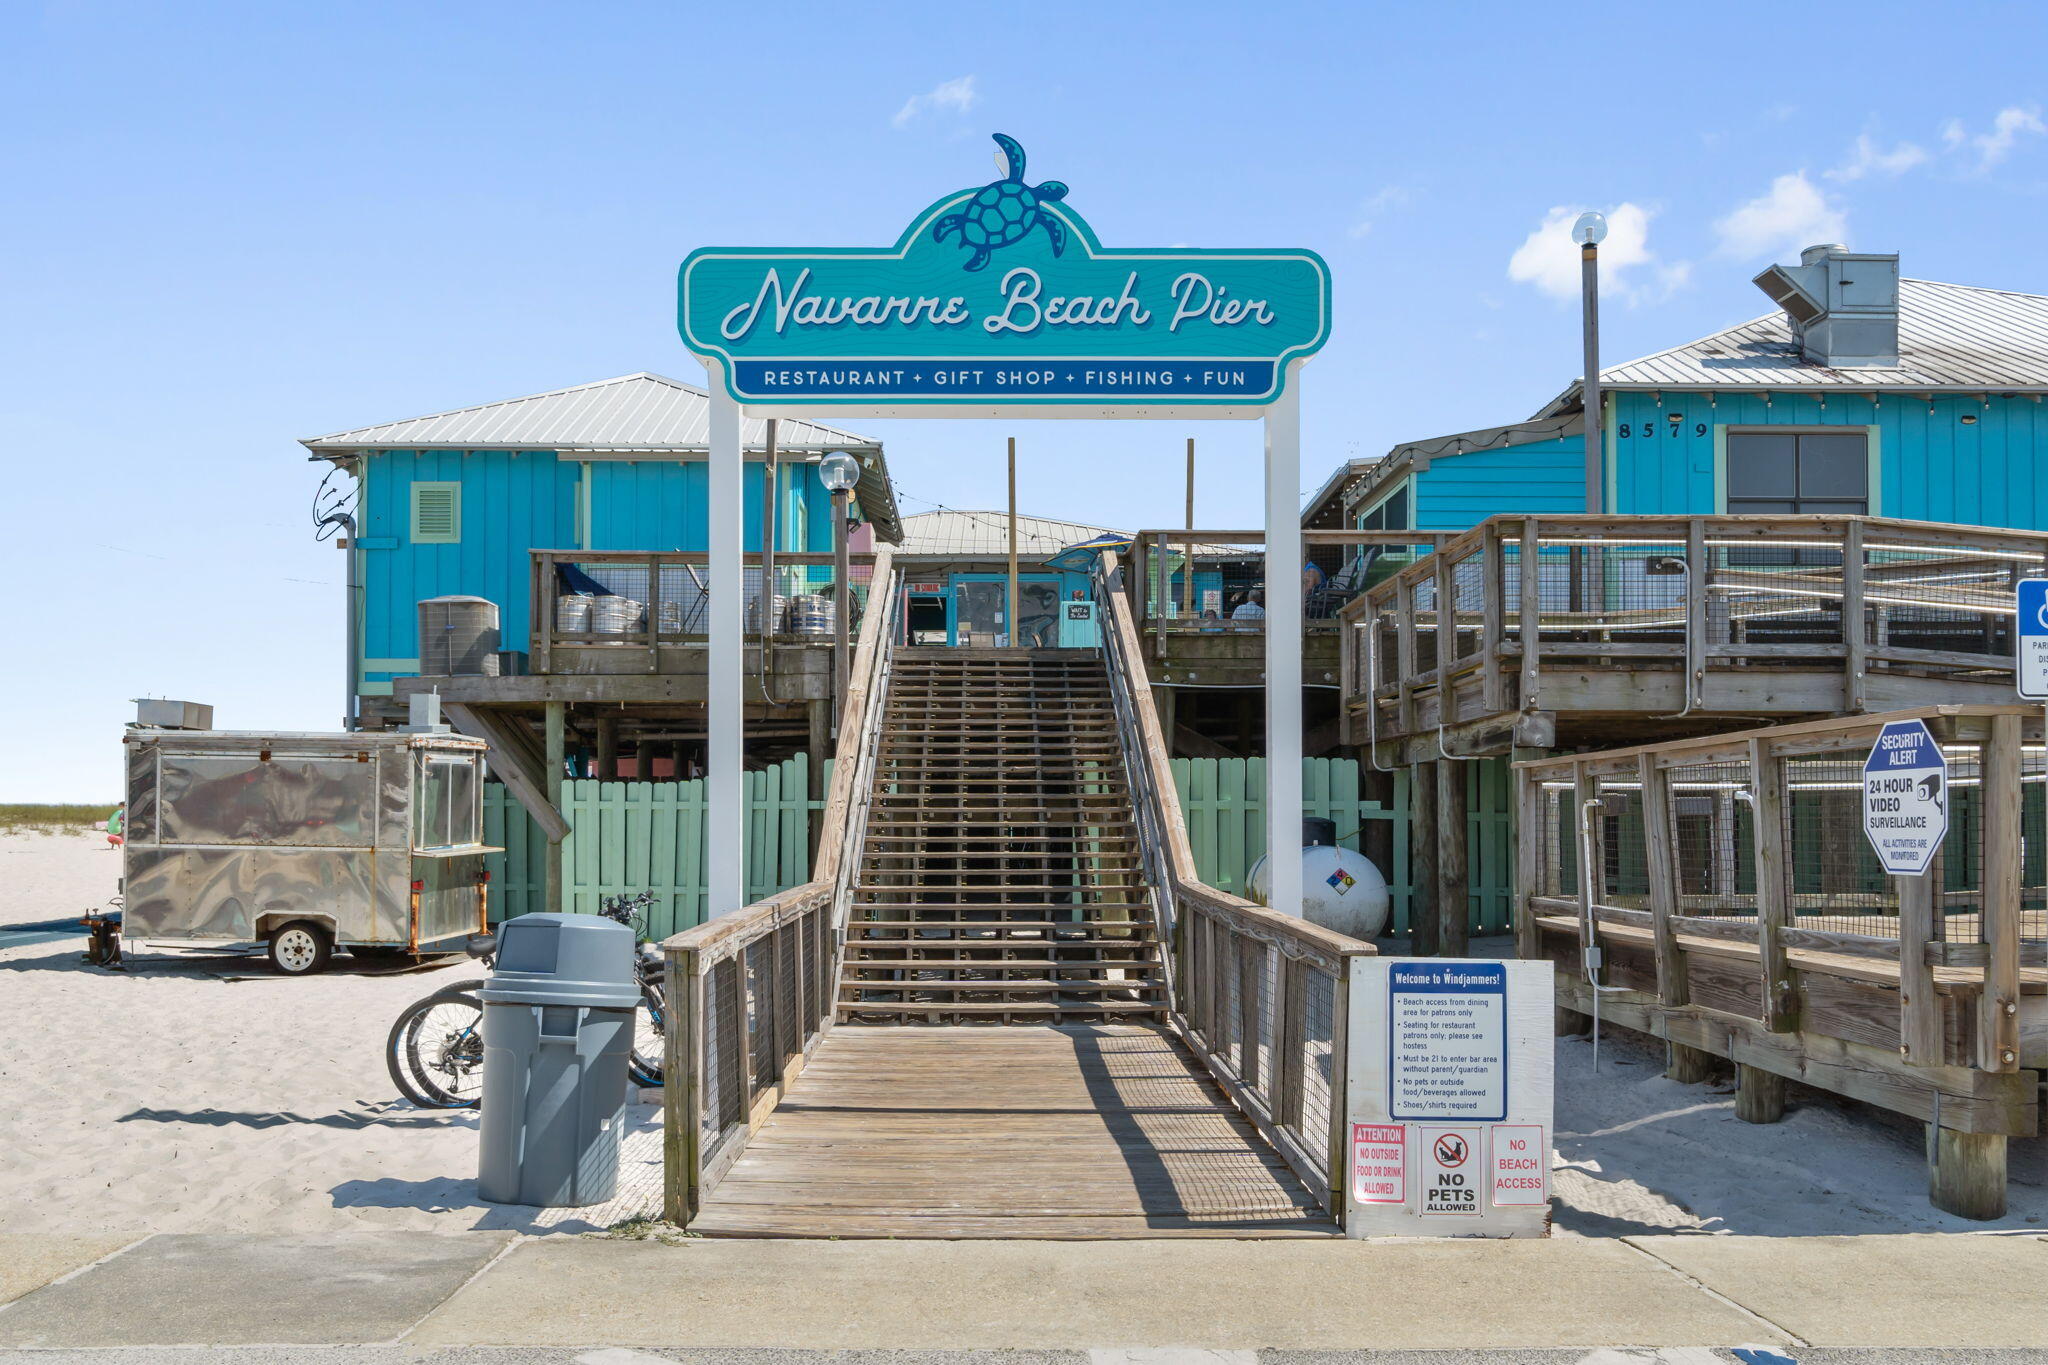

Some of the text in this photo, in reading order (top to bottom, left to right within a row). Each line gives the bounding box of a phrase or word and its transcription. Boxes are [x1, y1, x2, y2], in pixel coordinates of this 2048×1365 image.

[720, 267, 1275, 340] Navarre Beach Pier
[764, 371, 1245, 385] RESTAURANT GIFT SHOP FISHING FUN
[1618, 424, 1707, 438] 8579
[1882, 732, 1924, 750] SECURITY
[1889, 750, 1918, 766] ALERT
[1870, 778, 1912, 794] 24 HOUR
[1870, 798, 1900, 812] VIDEO
[1870, 816, 1926, 828] SURVEILLANCE
[1882, 839, 1927, 848] ALL ACTIVITIES ARE
[1395, 973, 1500, 988] Welcome to Windjammers!
[1468, 998, 1488, 1008] dining
[1458, 1009, 1472, 1017] only
[1403, 1022, 1428, 1030] Seating
[1448, 1032, 1469, 1040] please
[1432, 1065, 1488, 1075] parent/guardian
[1403, 1088, 1457, 1098] food/beverages
[1403, 1101, 1446, 1110] Shoes/shirts
[1357, 1128, 1400, 1141] ATTENTION
[1510, 1140, 1526, 1150] NO
[1360, 1148, 1399, 1160] NO OUTSIDE
[1500, 1158, 1537, 1170] BEACH
[1357, 1165, 1401, 1178] FOOD OR DRINK
[1439, 1174, 1464, 1186] NO
[1496, 1178, 1541, 1189] ACCESS
[1364, 1182, 1394, 1194] ALLOWED
[1428, 1189, 1474, 1201] PETS
